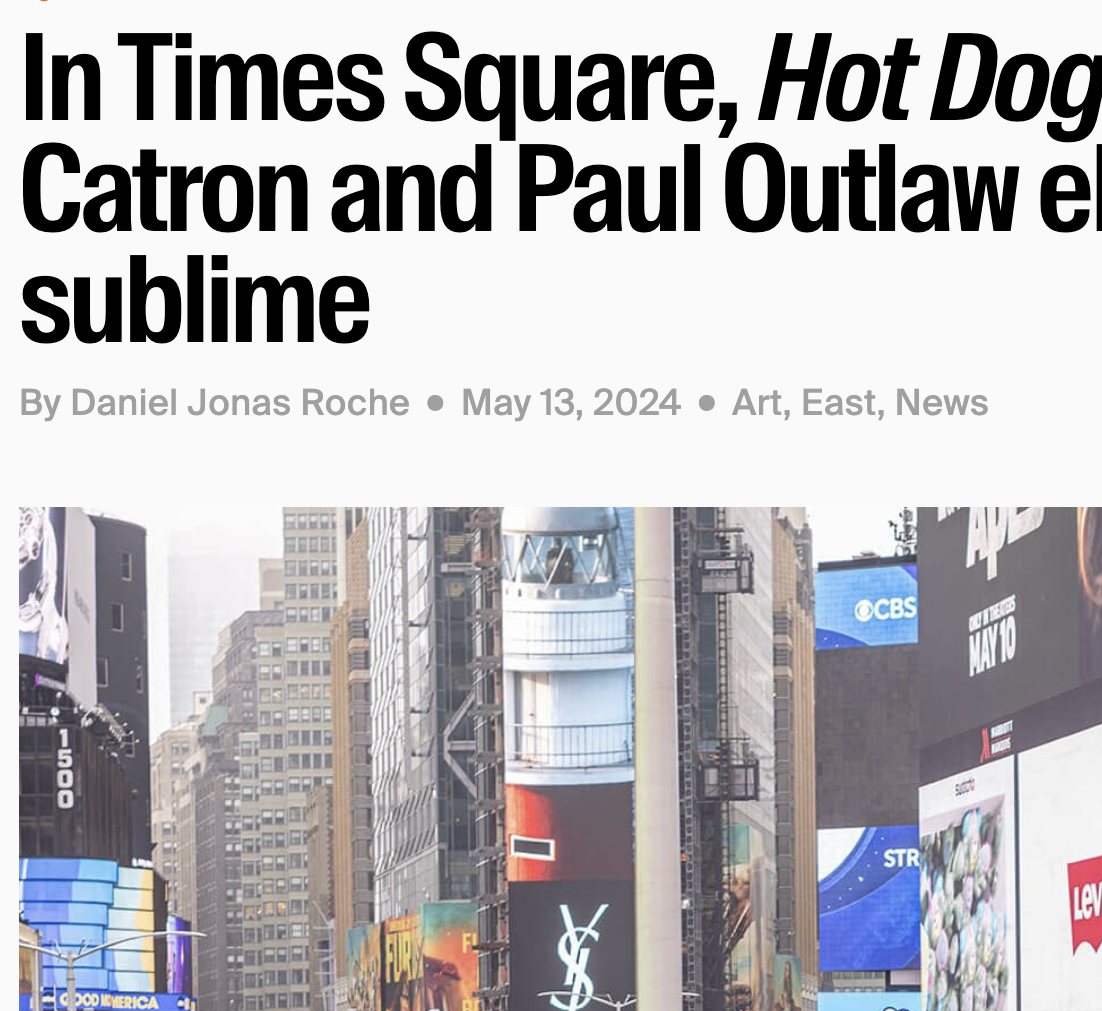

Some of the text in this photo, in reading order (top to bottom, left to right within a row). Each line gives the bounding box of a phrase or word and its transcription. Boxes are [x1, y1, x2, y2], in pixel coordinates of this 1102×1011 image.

[874, 596, 917, 620] CBS
[969, 615, 1016, 677] MAY 10
[57, 728, 73, 809] 1500
